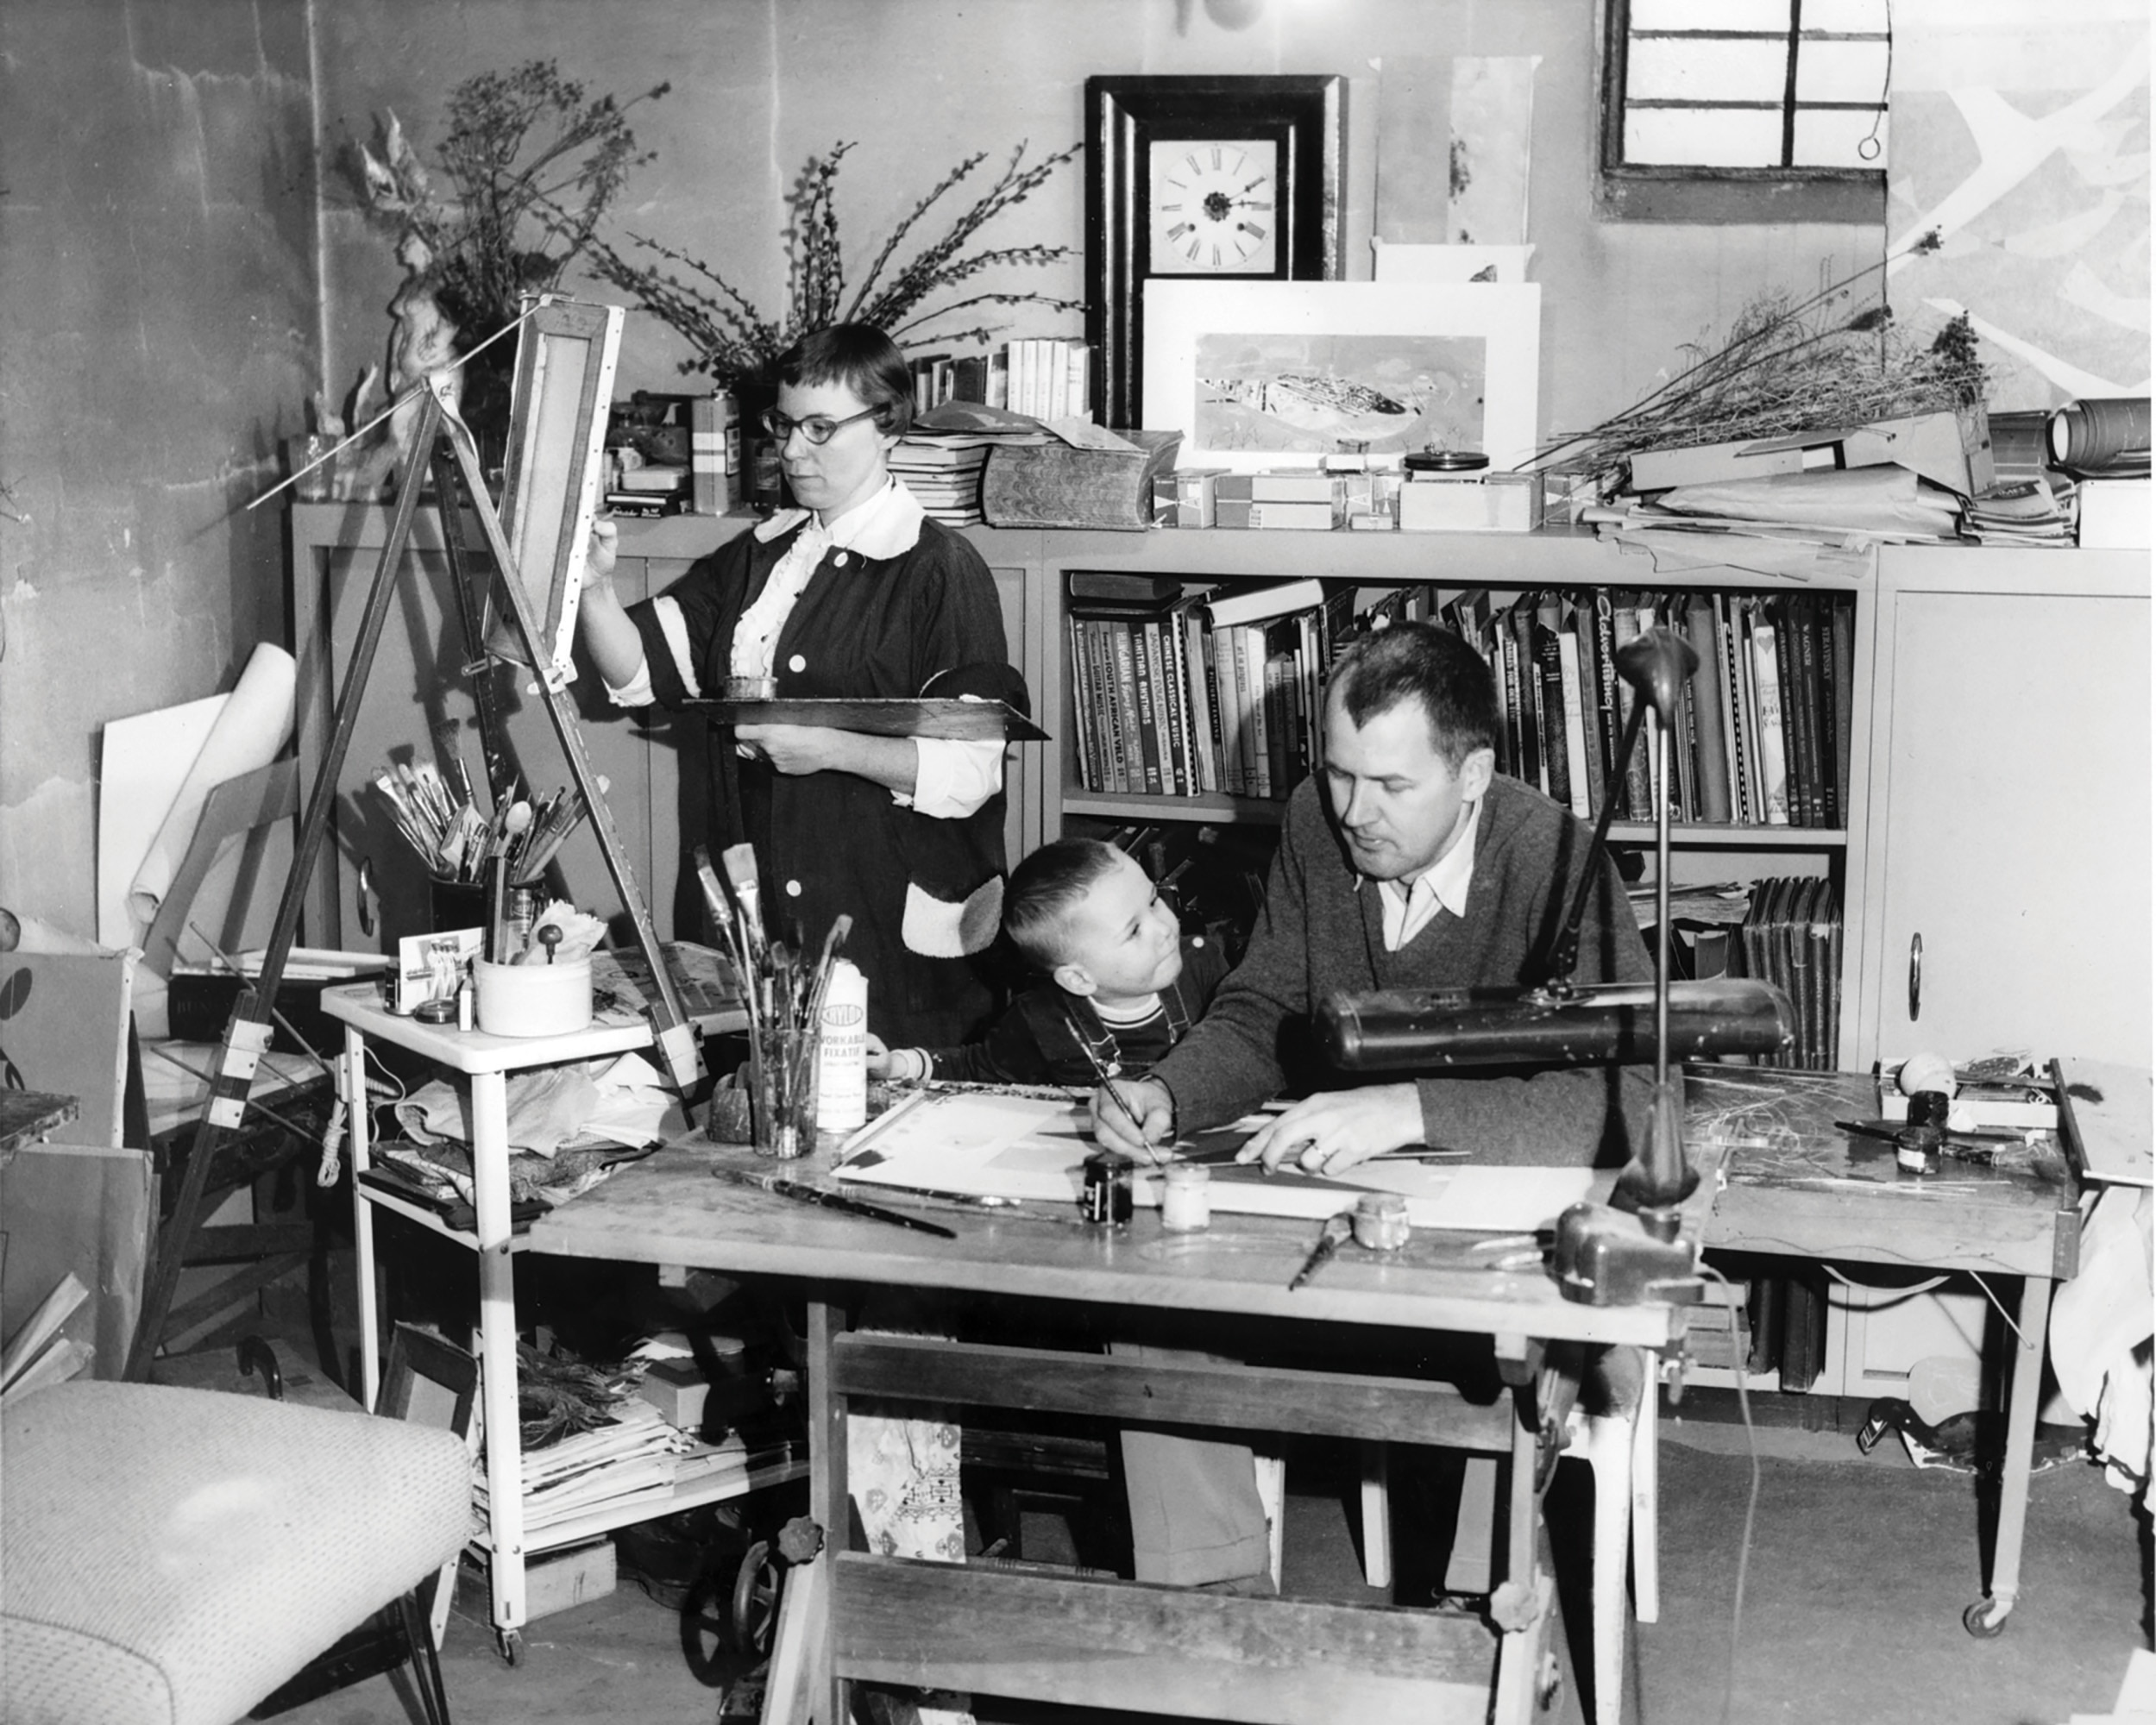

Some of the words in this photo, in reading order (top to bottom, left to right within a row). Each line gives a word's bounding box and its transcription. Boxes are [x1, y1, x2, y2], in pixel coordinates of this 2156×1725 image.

[1116, 630, 1131, 683] HUNGARIAN
[1135, 631, 1146, 676] TAHITIAN
[1149, 630, 1160, 678] JAPANESE
[1163, 634, 1172, 671] CHINESE
[1596, 595, 1616, 712] Advertising
[1779, 630, 1789, 674] STRAVINSKY
[1802, 623, 1813, 667] WAGNER
[1821, 625, 1832, 681] STRAVINSKY
[1093, 664, 1102, 691] GUITAR
[1104, 661, 1115, 693] SOUTH
[1166, 672, 1178, 718] CLASSICAL
[1237, 665, 1247, 693] progress
[1109, 694, 1121, 737] AFRICAN
[1139, 680, 1151, 725] RHYTHMS
[1172, 718, 1180, 748] MUSIC
[824, 1046, 860, 1057] FIXATIF
